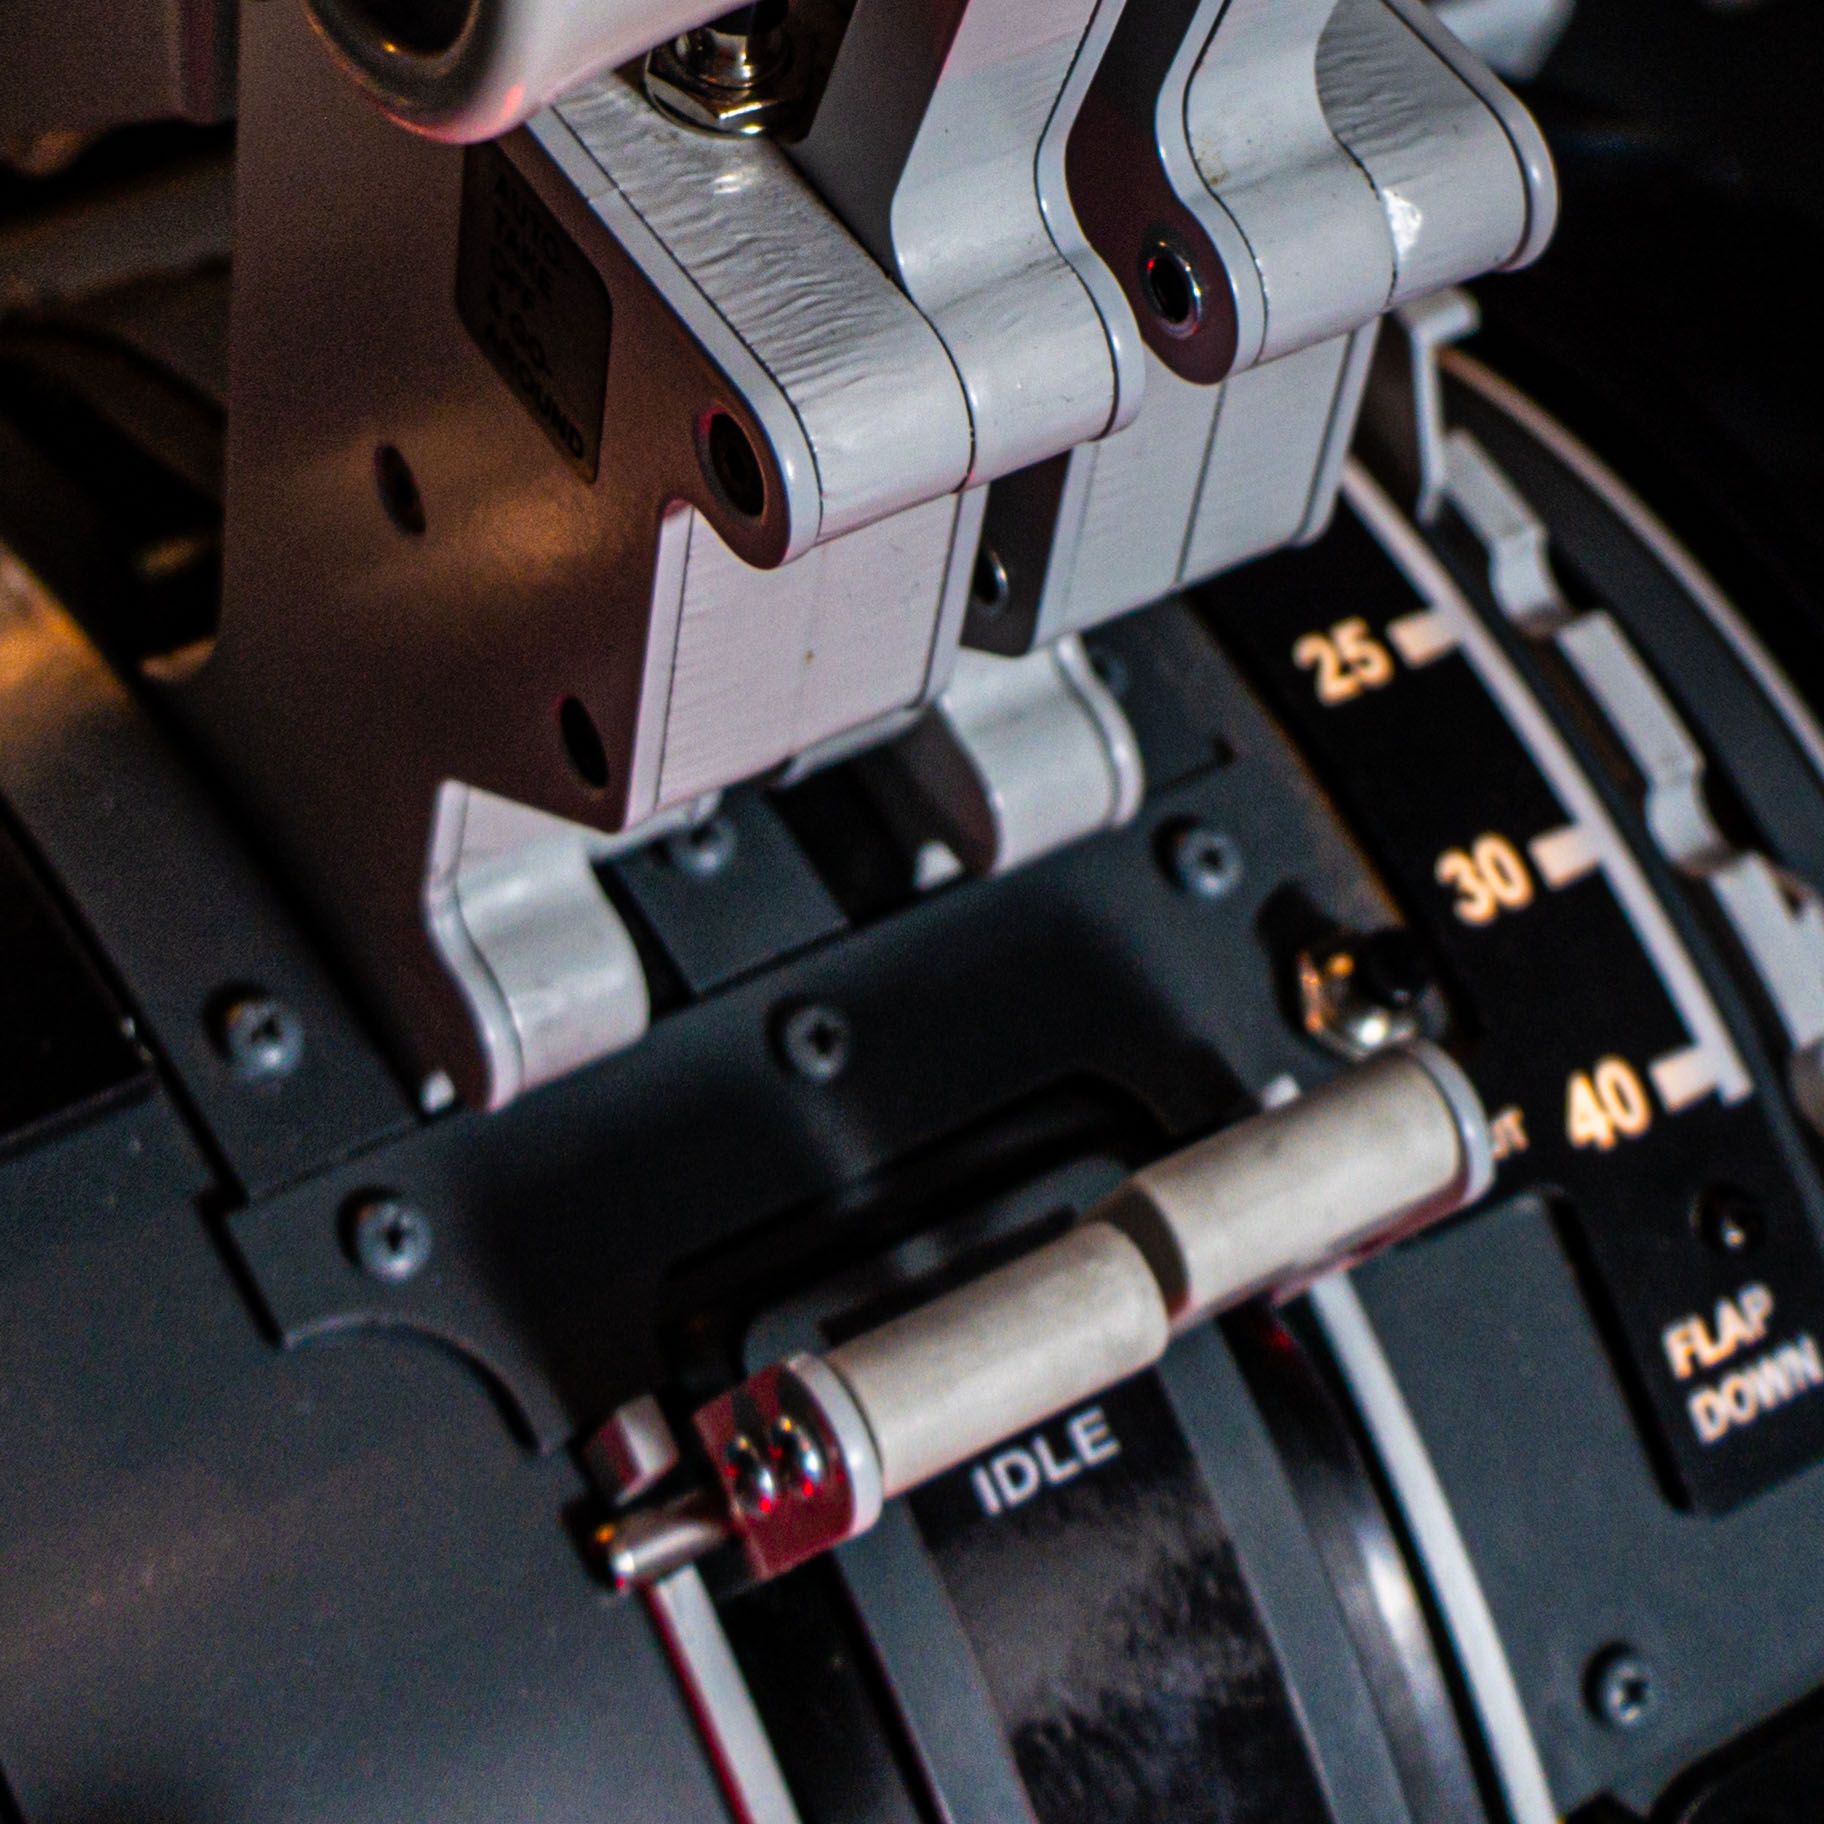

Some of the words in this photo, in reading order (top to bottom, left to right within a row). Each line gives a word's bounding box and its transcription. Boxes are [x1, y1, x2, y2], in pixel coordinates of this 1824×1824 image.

[1292, 617, 1393, 706] 25
[1436, 832, 1534, 926] 30
[1566, 1053, 1652, 1150] 40
[1661, 1282, 1774, 1381] FLAP
[971, 1404, 1121, 1517] IDLE
